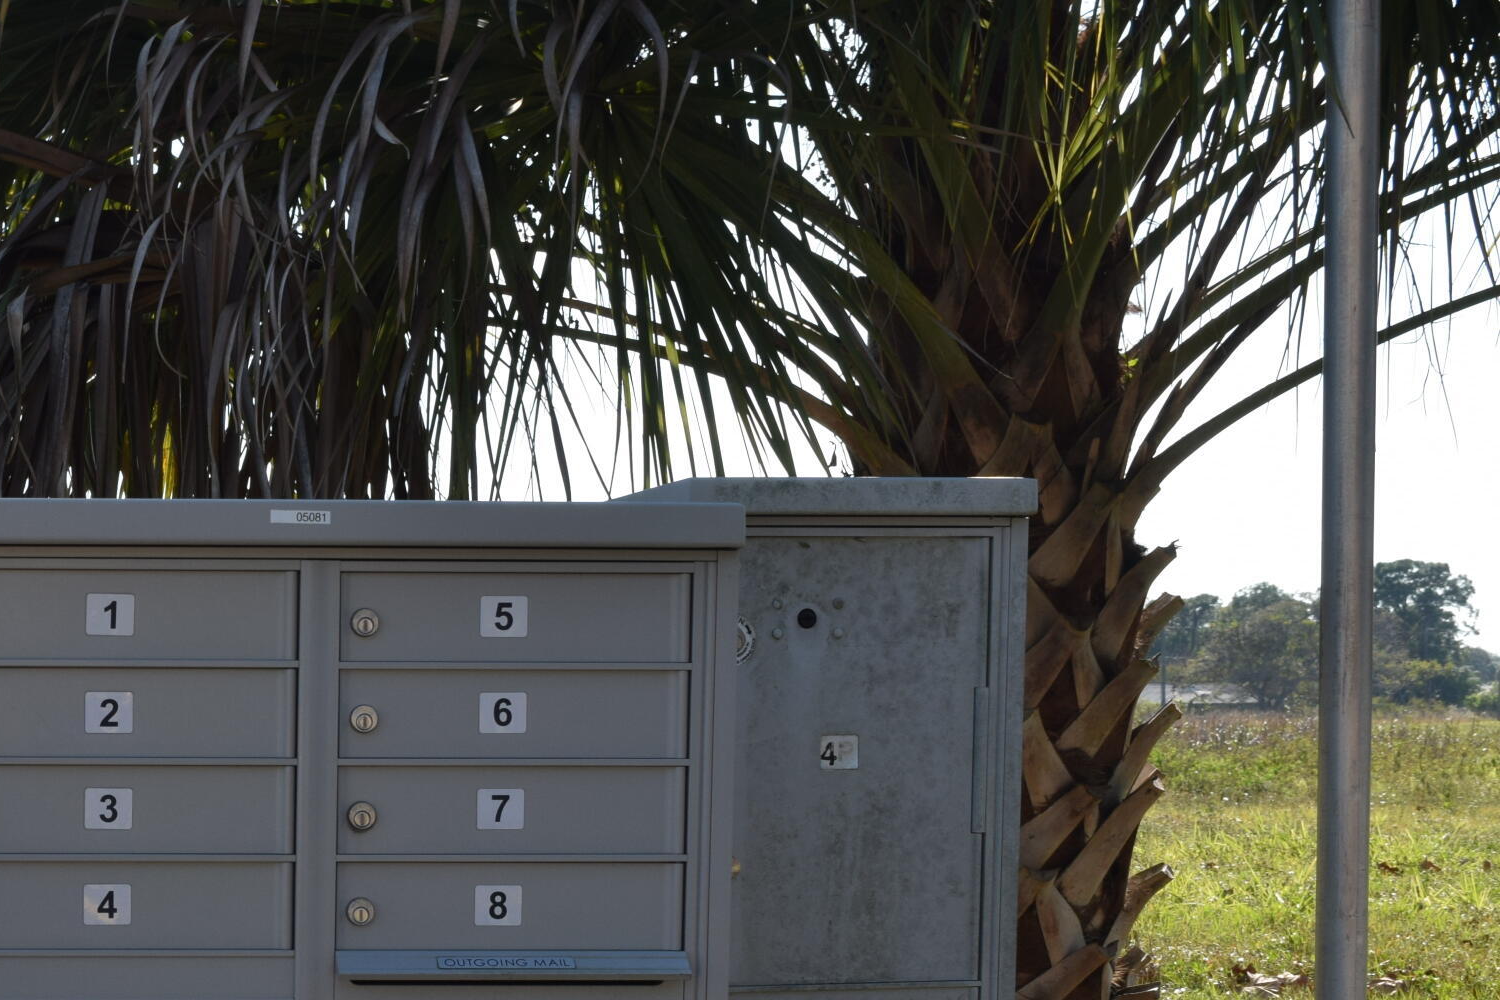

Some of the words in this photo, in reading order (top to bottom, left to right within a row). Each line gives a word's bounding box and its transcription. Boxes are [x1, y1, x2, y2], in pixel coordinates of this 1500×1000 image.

[296, 512, 326, 522] 05081
[103, 600, 117, 630] 1
[494, 602, 514, 631] 5
[99, 698, 119, 728] 2
[493, 697, 513, 727] 6
[99, 794, 118, 823] 3
[491, 794, 510, 823] 7
[97, 890, 118, 919] 4
[488, 890, 508, 920] 8
[444, 958, 528, 967] OUTGOING
[534, 958, 570, 967] MAIL
